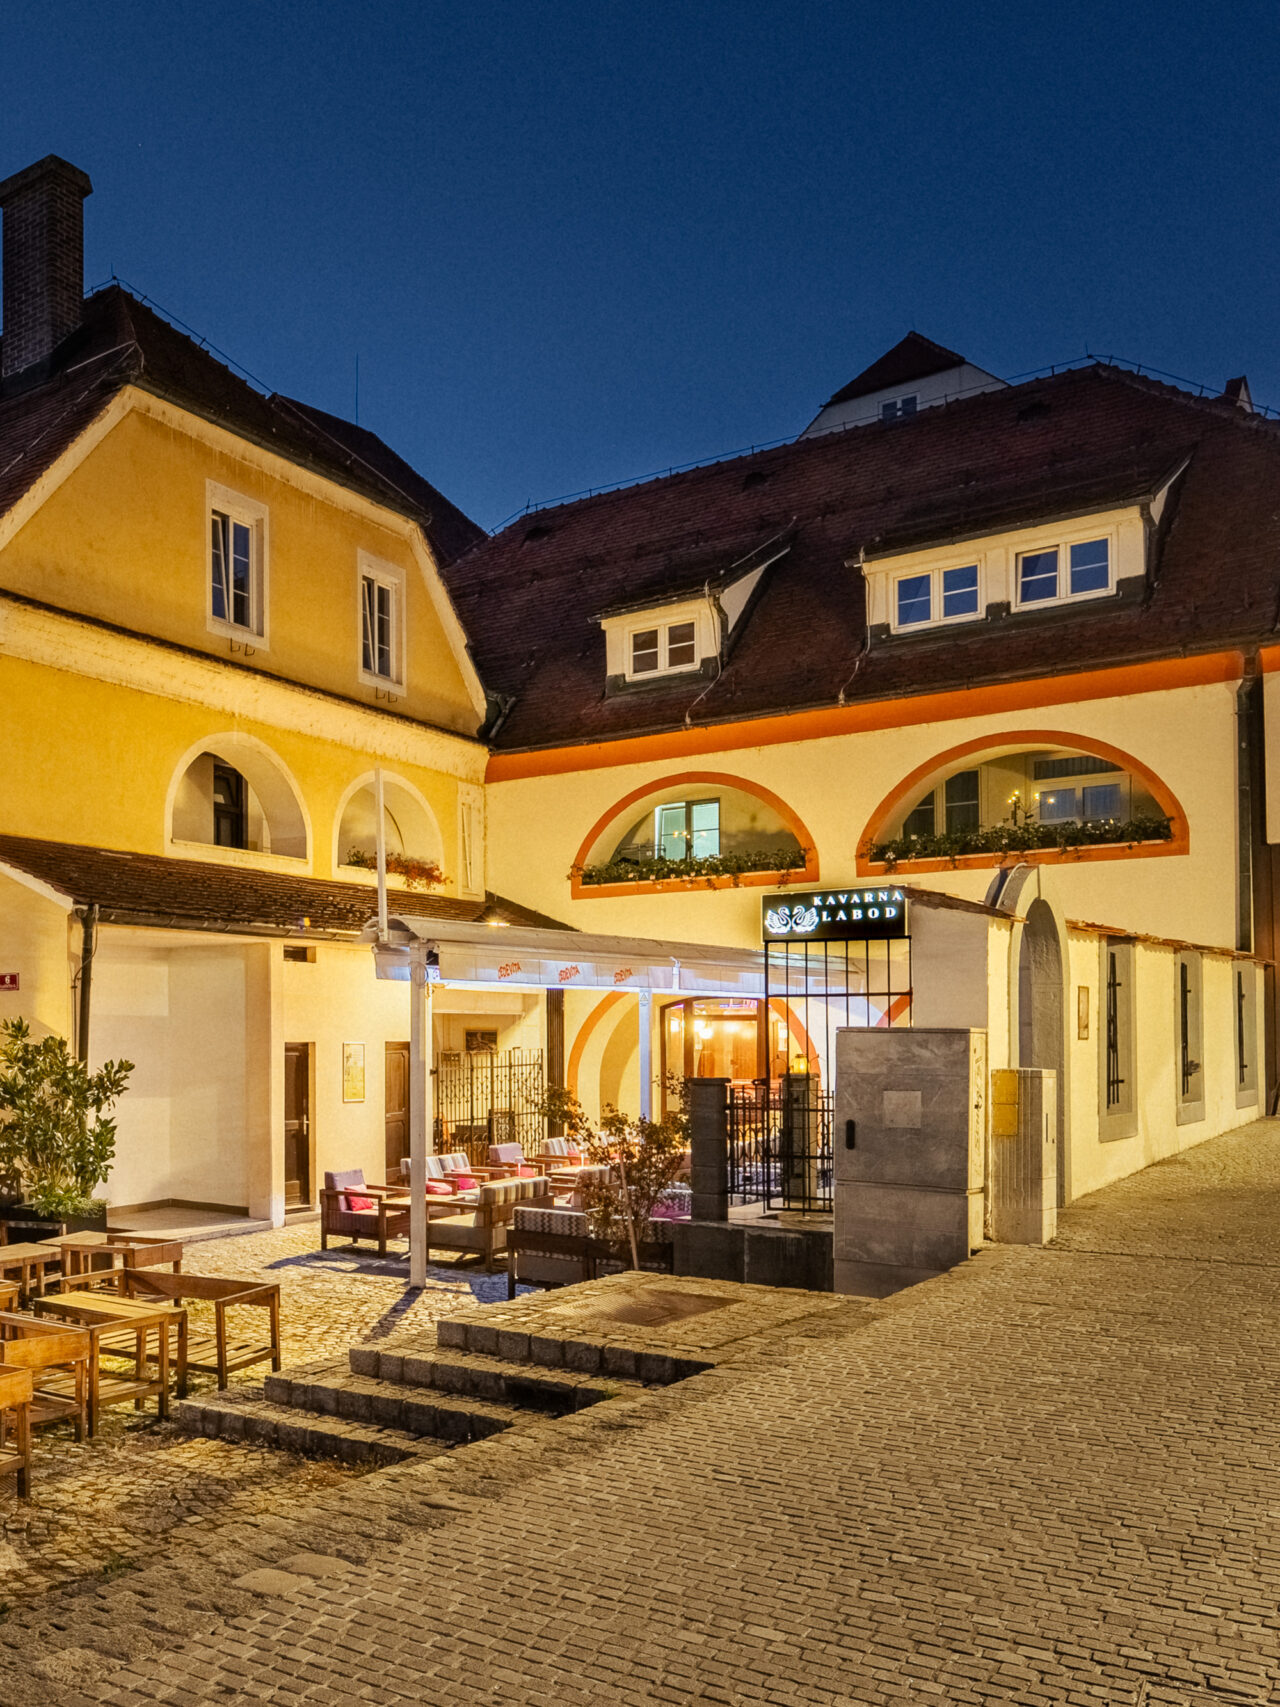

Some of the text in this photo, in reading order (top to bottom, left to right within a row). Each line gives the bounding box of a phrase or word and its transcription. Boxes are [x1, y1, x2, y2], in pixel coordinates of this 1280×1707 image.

[813, 890, 904, 906] KAVARNA
[822, 907, 897, 922] LABOD
[4, 975, 11, 984] 6
